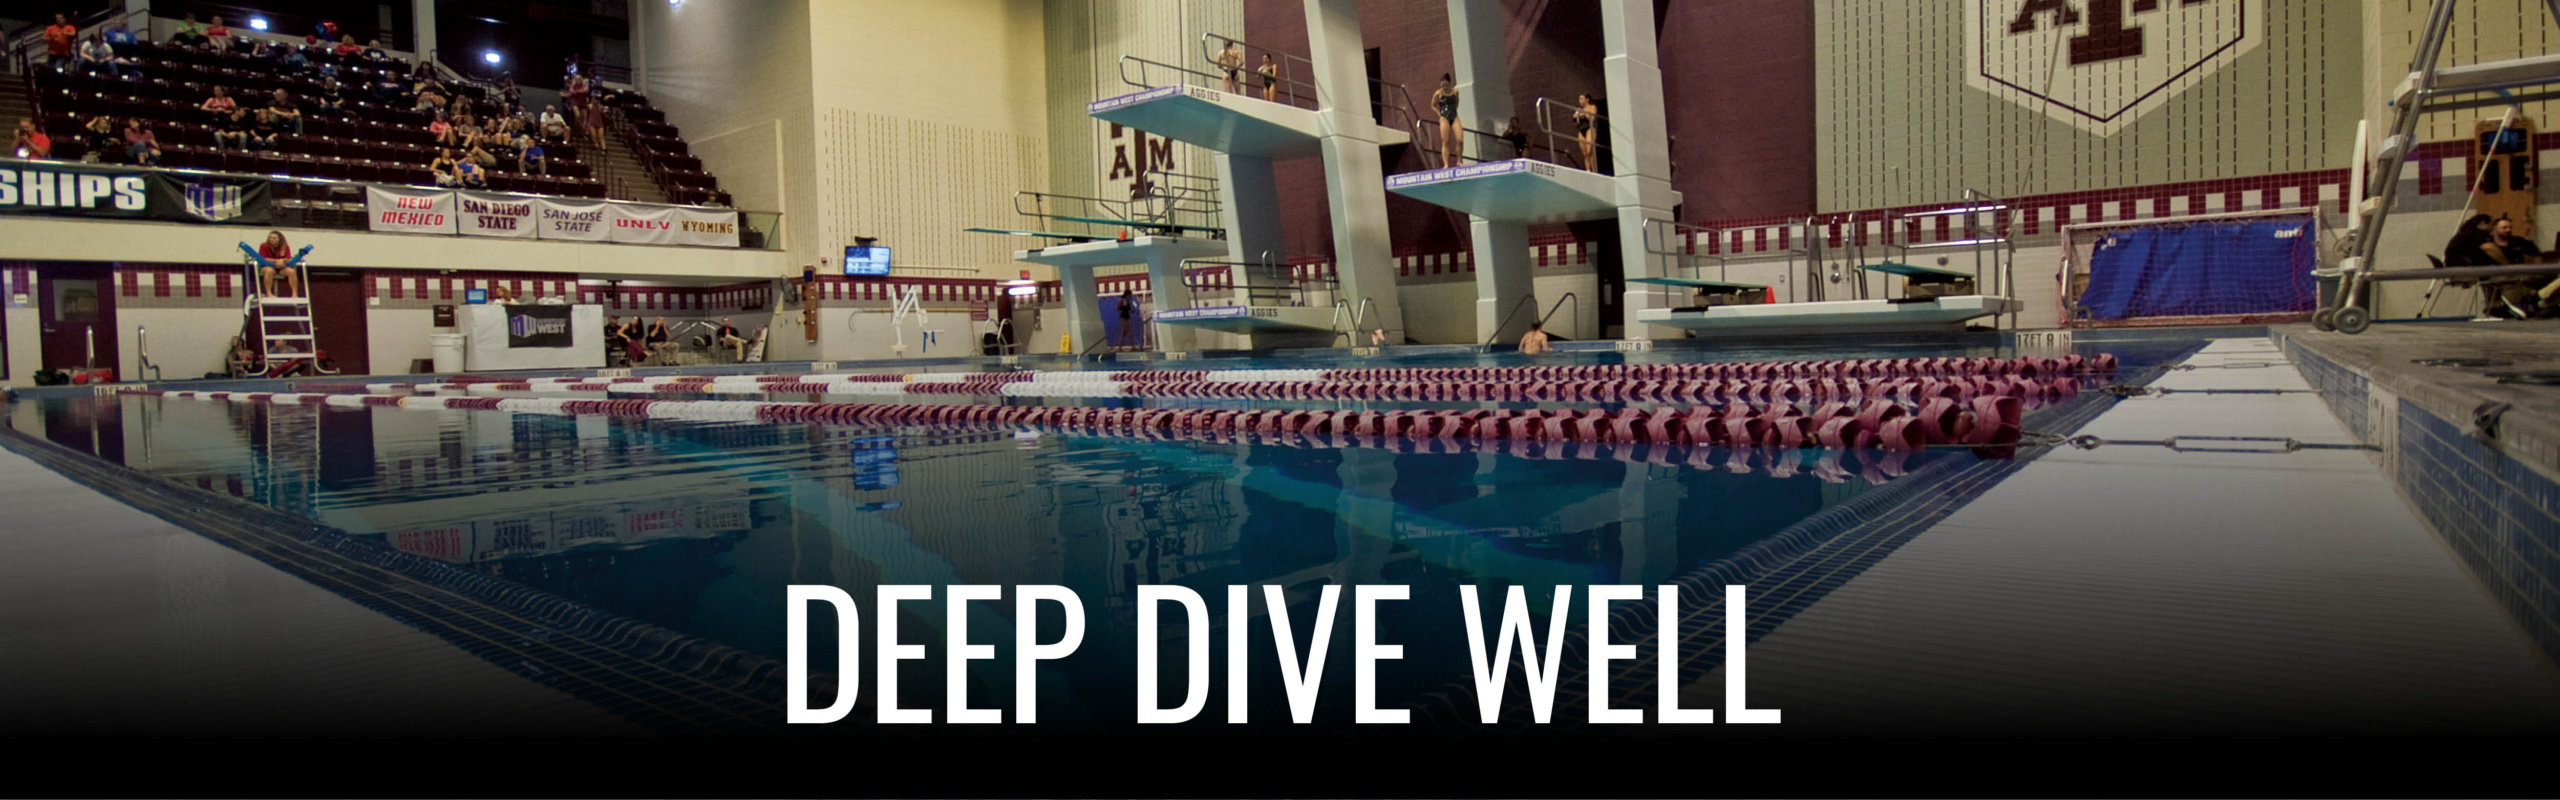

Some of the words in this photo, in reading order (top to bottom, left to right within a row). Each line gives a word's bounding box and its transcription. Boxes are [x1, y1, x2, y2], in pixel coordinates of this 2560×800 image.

[1190, 87, 1220, 102] AGGIES
[1396, 173, 1432, 185] MOUNTAIN
[1434, 169, 1454, 180] WEST
[1455, 162, 1512, 178] CHAMPIONSHIP
[1531, 162, 1555, 177] AGGIES
[396, 197, 433, 210] NEW
[463, 200, 489, 213] SAN
[492, 202, 530, 217] DIEGO
[381, 211, 444, 226] MEXICO
[543, 209, 571, 220] SAN
[478, 215, 517, 230] STATE
[555, 220, 592, 232] STATE
[616, 218, 670, 230] UNLV
[681, 220, 734, 234] WYOMING
[1251, 308, 1278, 318] AGGIES
[537, 324, 566, 334] WEST
[2017, 333, 2042, 345] 17FT
